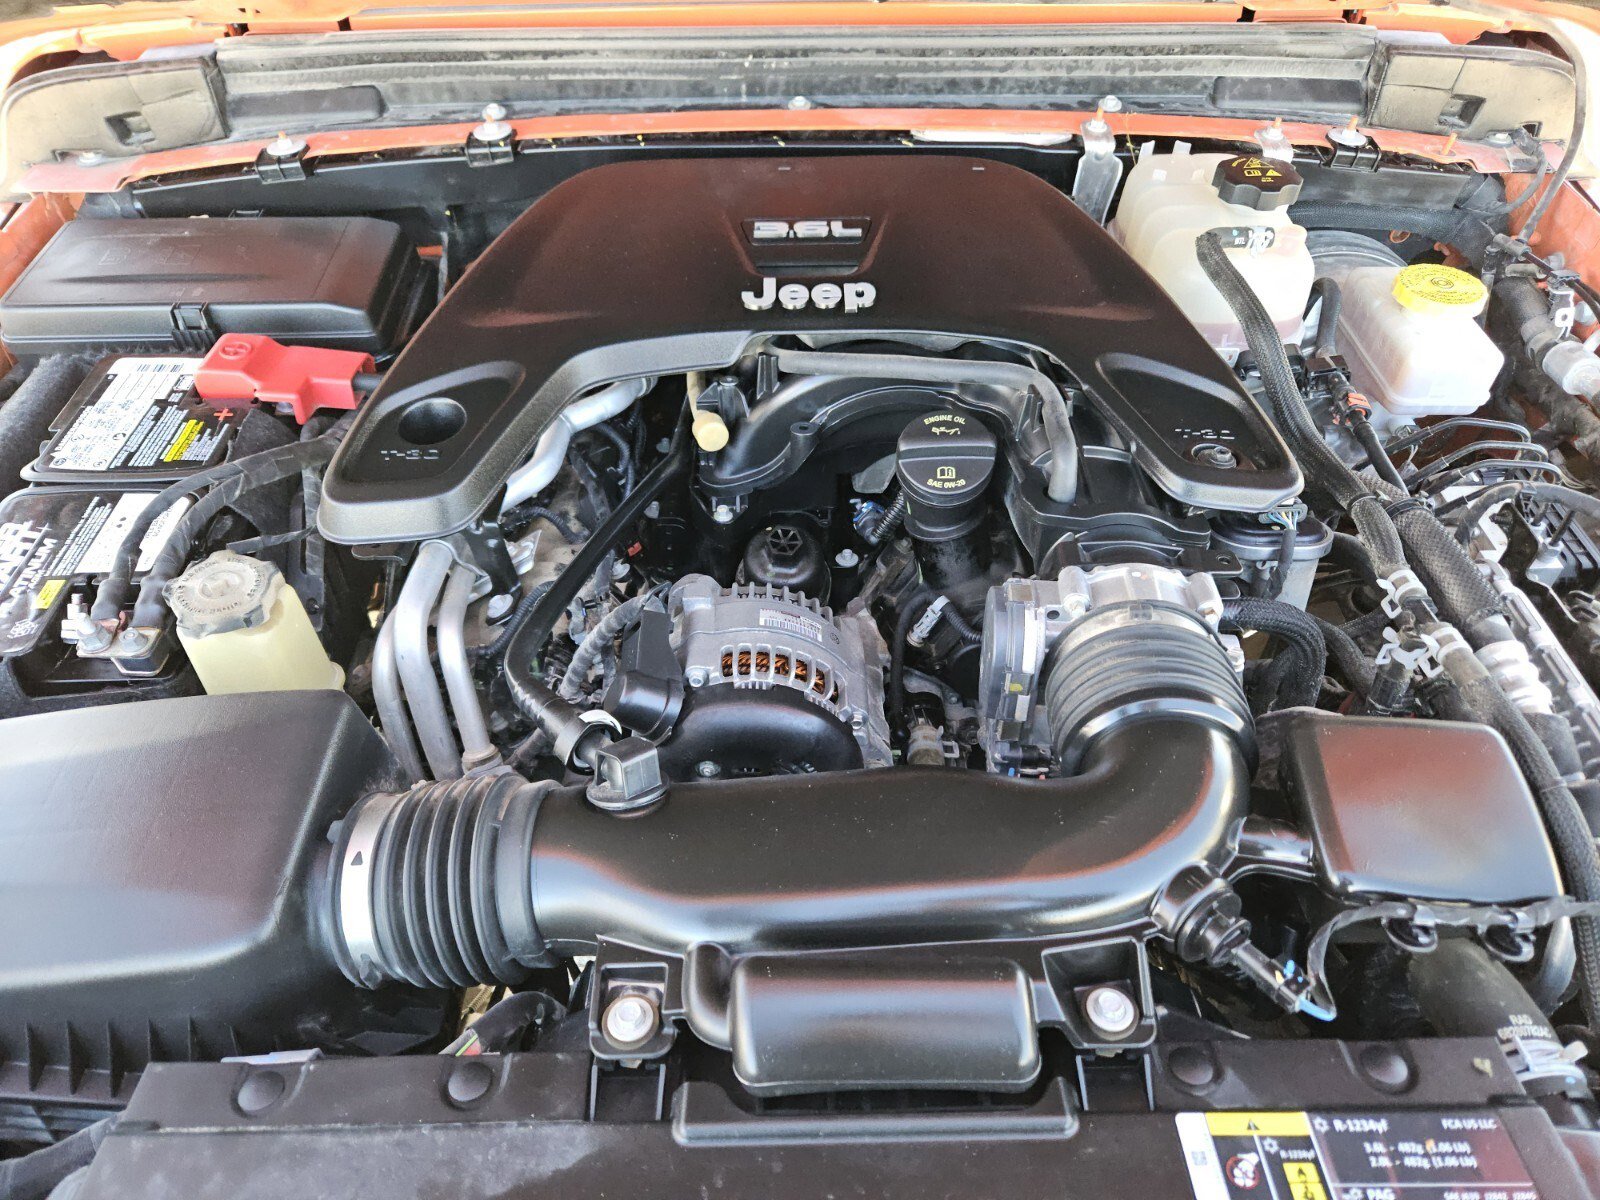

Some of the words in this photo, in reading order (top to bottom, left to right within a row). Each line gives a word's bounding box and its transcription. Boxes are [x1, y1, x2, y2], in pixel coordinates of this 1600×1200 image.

[754, 220, 862, 238] 3.6L
[741, 277, 877, 313] Jeep
[924, 415, 953, 425] ENGINE
[954, 416, 966, 425] OIL
[927, 479, 943, 488] SAE
[944, 479, 966, 489] 0W-20
[1441, 1118, 1463, 1130] FCA
[1463, 1118, 1478, 1130] US
[1478, 1118, 1498, 1130] LLC
[1366, 1188, 1395, 1200] PAG
